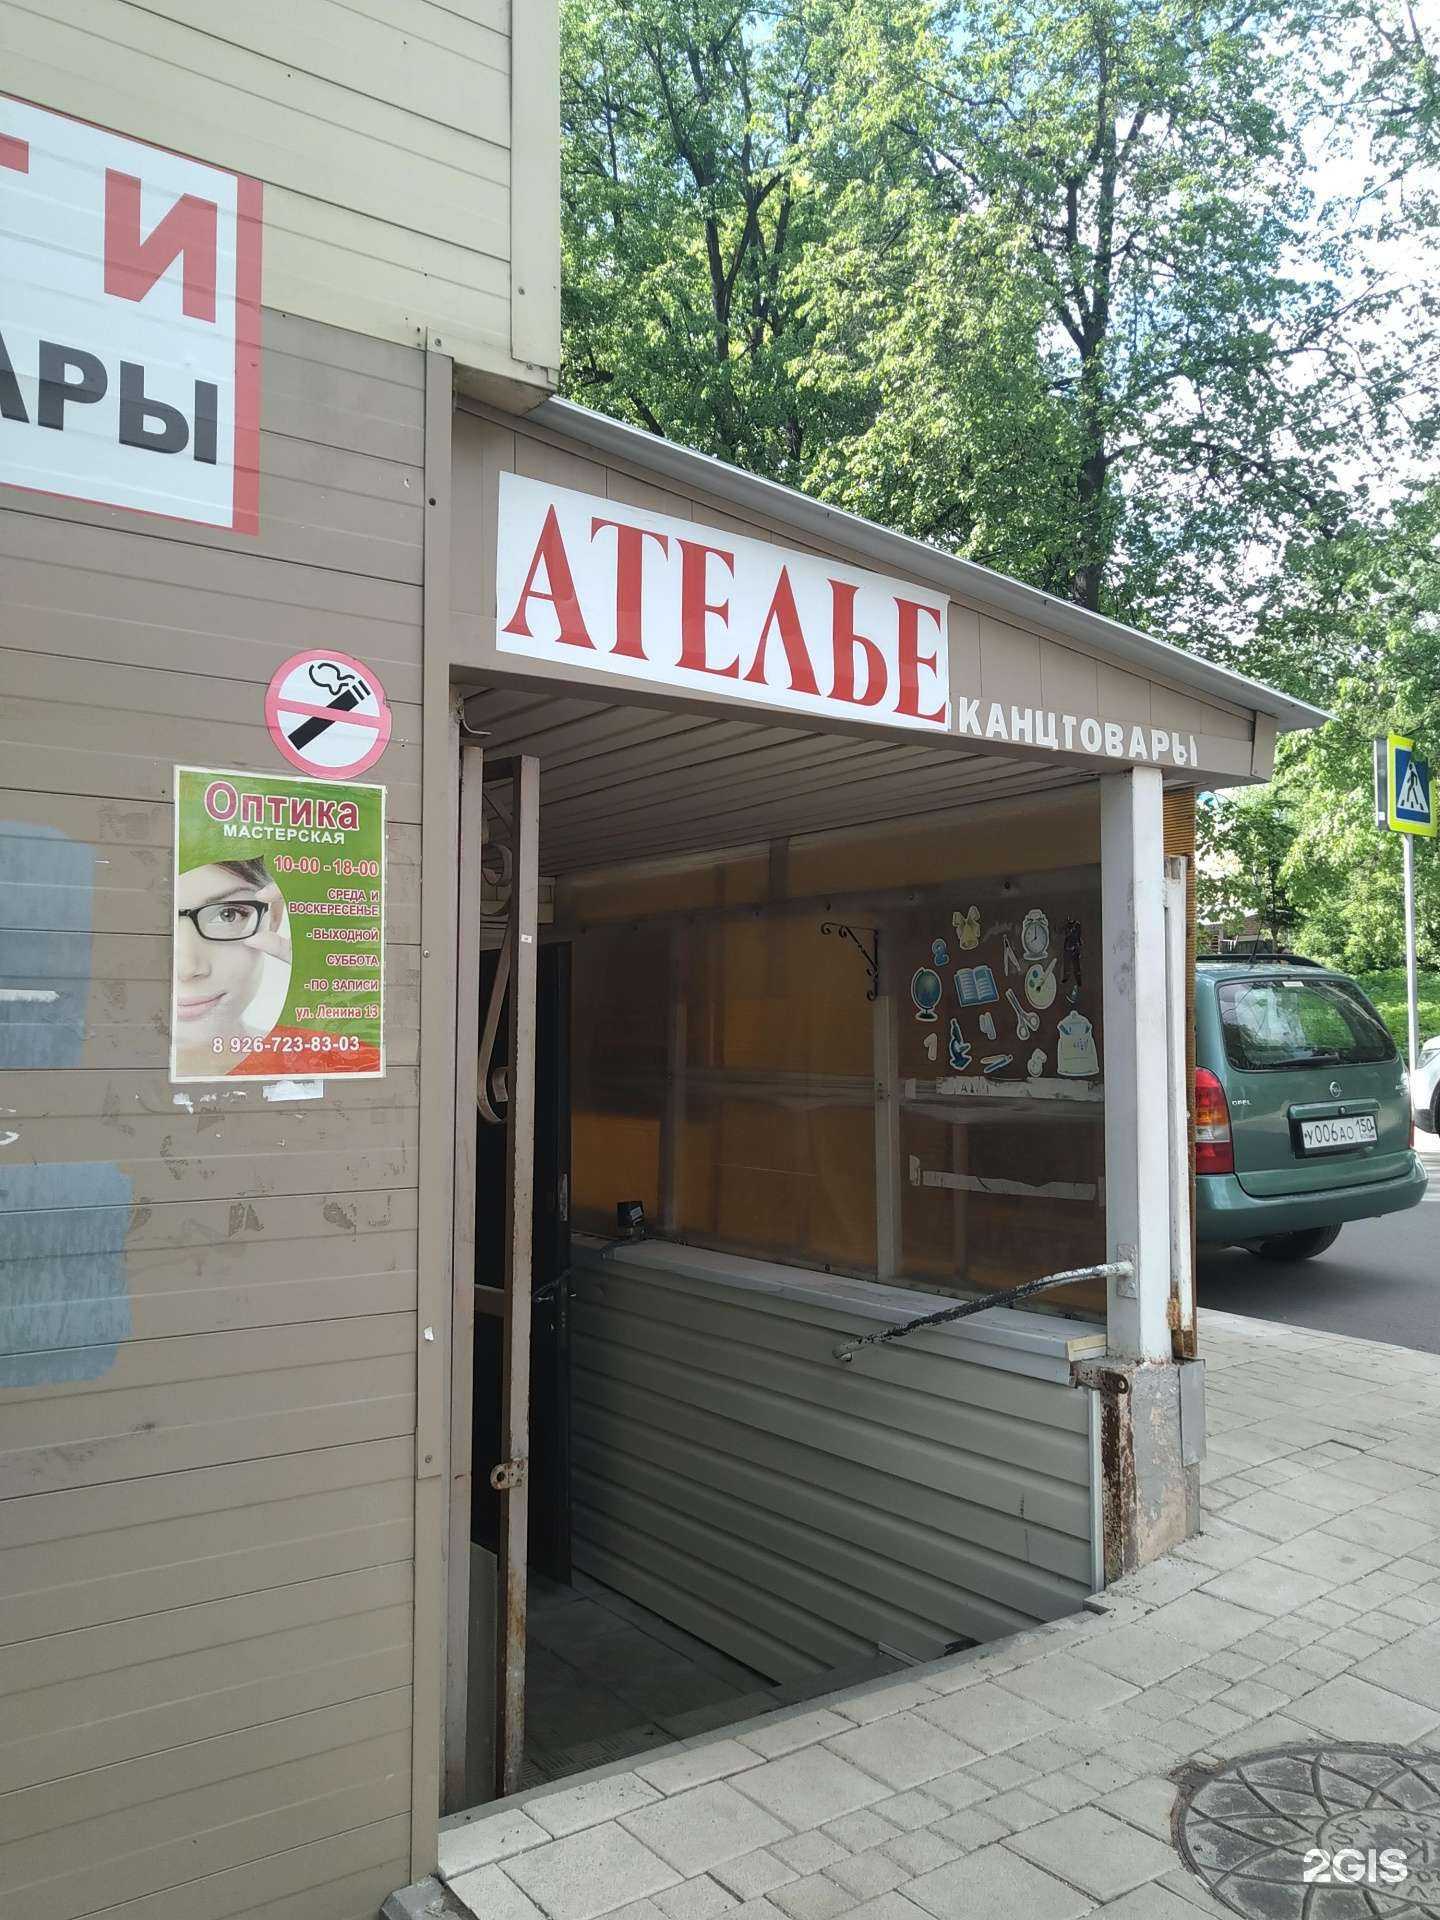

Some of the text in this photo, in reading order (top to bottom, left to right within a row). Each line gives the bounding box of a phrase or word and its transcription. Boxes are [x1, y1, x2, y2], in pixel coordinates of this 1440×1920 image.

[0, 133, 217, 323] И
[501, 503, 946, 723] АТЕЛЬЕ
[959, 696, 1198, 767] КАНЦТОВАРЫ
[204, 780, 360, 831] Оптика
[223, 824, 345, 844] МАСТЕРСКАЯ
[327, 888, 379, 902] СРЕДА И
[289, 902, 379, 916] ВОСКЕРЕСЕНЬЕ
[326, 954, 379, 966] СУББОТА
[333, 979, 379, 992] ЗАПИСИ
[296, 1005, 379, 1021] ул. Ленина 13
[212, 1036, 360, 1053] 8 926-723-83-03
